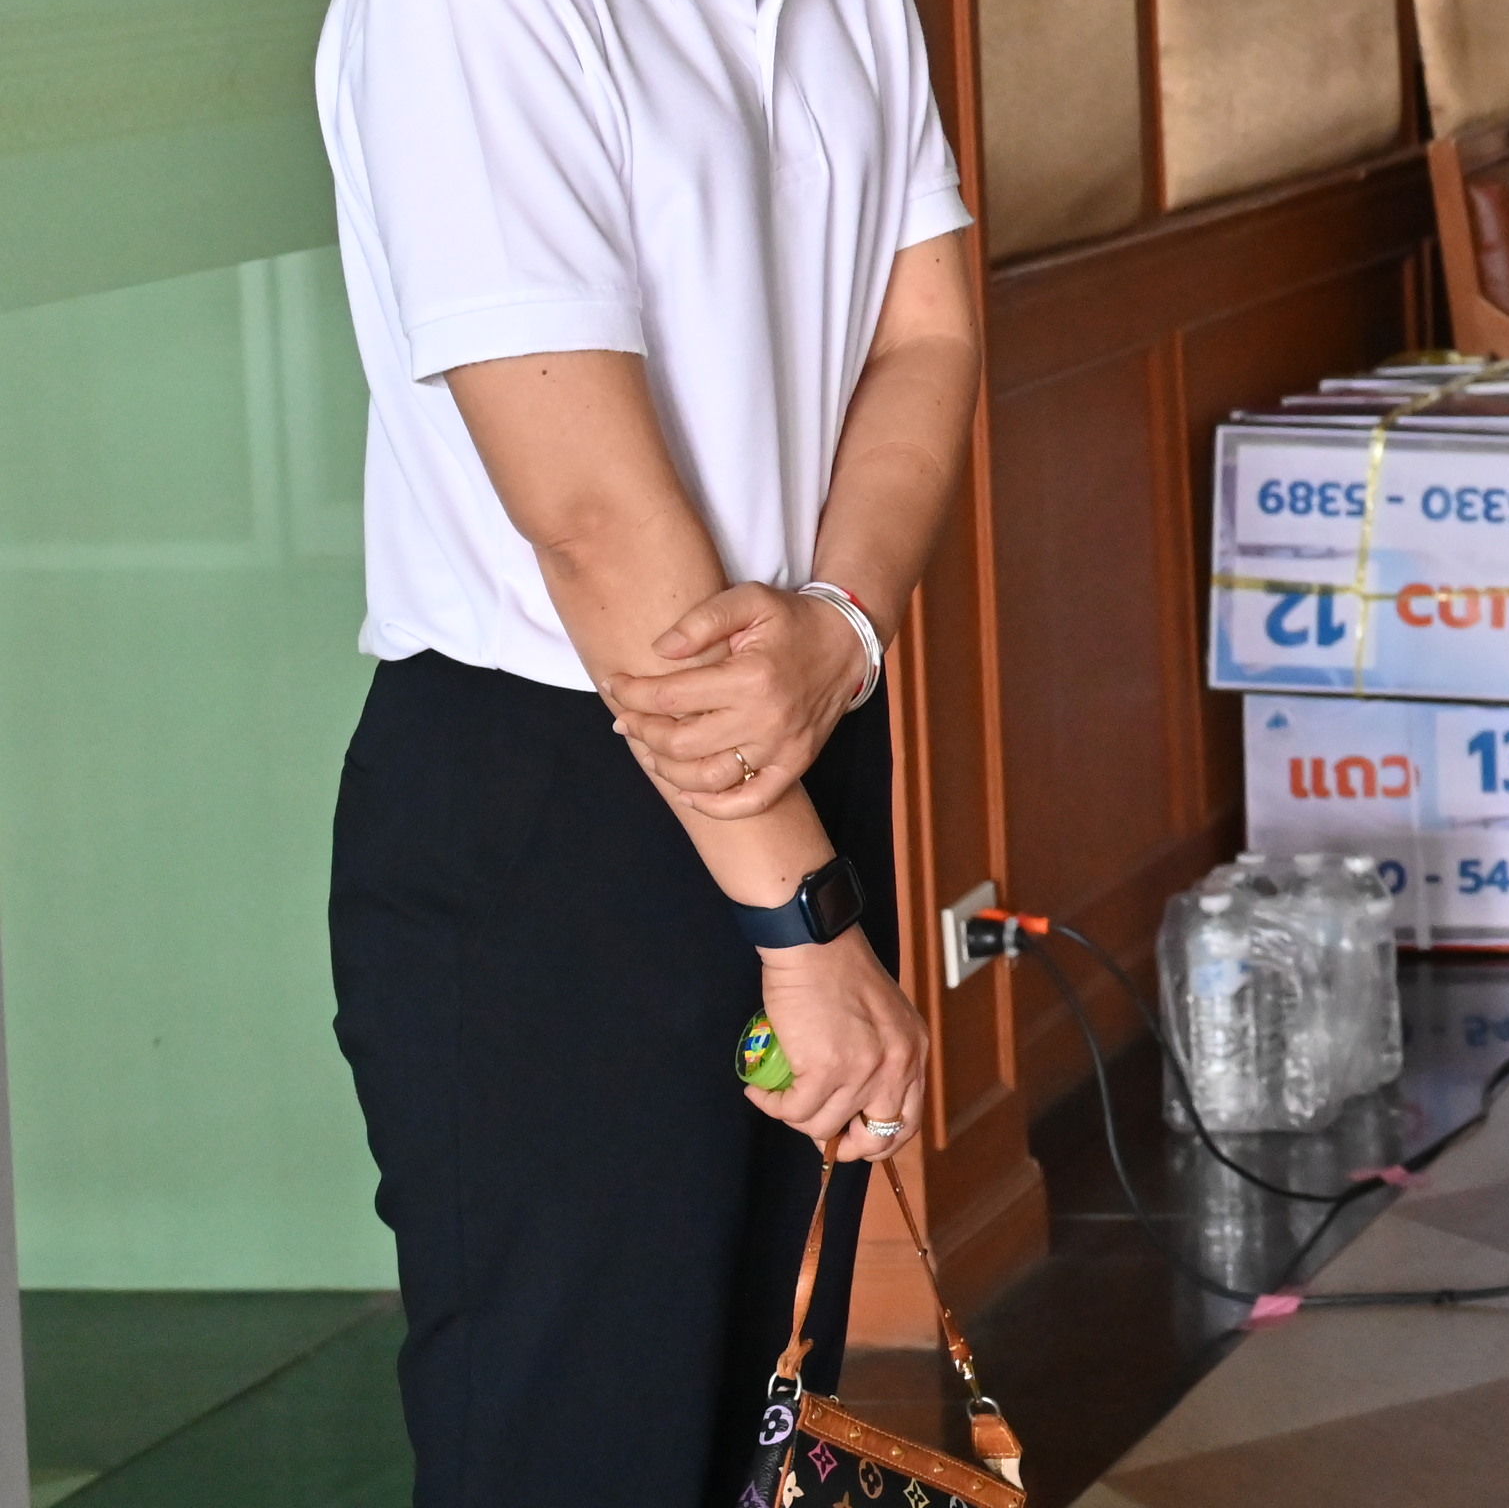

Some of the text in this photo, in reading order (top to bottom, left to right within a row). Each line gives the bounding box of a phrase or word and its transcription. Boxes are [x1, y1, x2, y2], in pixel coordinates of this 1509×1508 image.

[1256, 476, 1367, 519] 5389
[1264, 583, 1347, 649] 12
[1288, 753, 1418, 800] แถว
